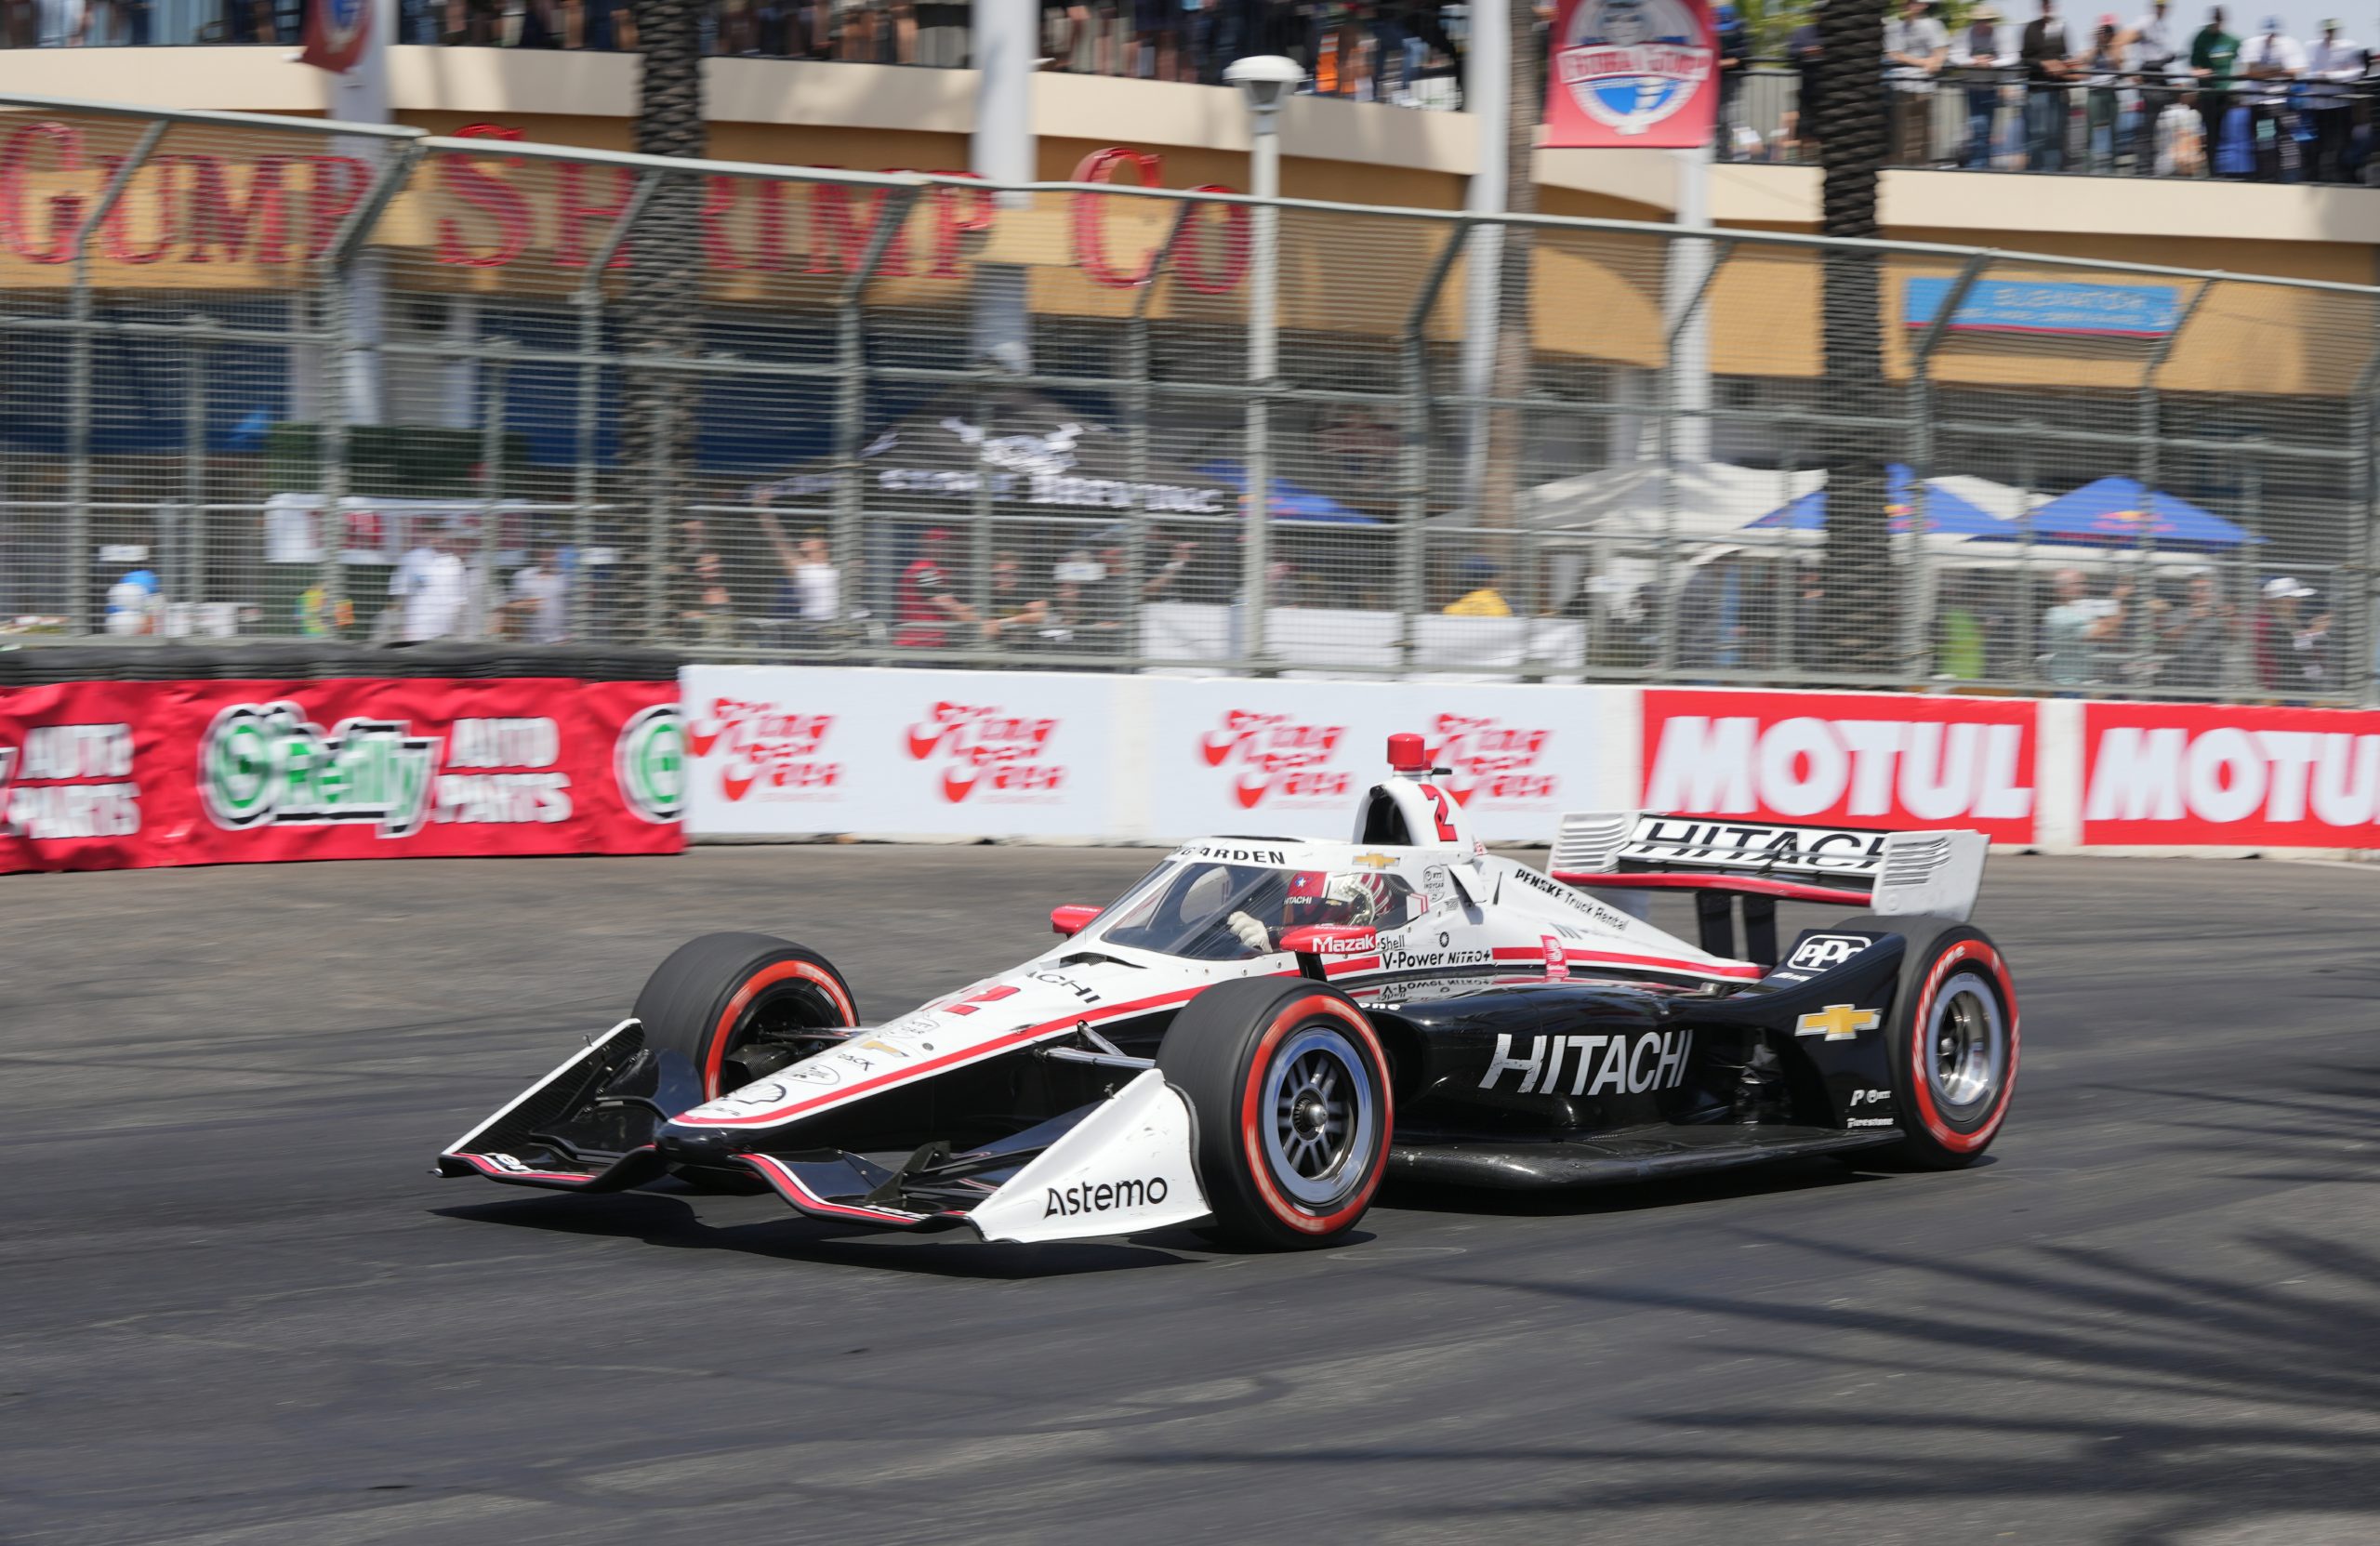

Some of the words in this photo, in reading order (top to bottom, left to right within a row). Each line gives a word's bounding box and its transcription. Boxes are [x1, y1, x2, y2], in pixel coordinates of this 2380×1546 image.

[0, 122, 377, 264] GUMP
[19, 723, 134, 779] AUTO
[448, 718, 560, 768] AUTO
[1646, 715, 2034, 819] MOTUL
[437, 773, 572, 823] PARTS
[2085, 727, 2380, 826] MOTU
[9, 783, 140, 839] PARTS
[1418, 784, 1458, 841] 2
[1177, 846, 1286, 865] GARDEN
[1637, 823, 1885, 870] HITAC
[1283, 896, 1314, 905] HITACHI
[1514, 868, 1565, 900] PENSKE
[1564, 892, 1594, 915] Truck
[1593, 906, 1630, 932] Rental
[1312, 933, 1375, 953] Mazak
[1381, 934, 1406, 950] Shell
[1382, 951, 1445, 970] V-Power
[1478, 1029, 1694, 1096] HITACHI
[1846, 1117, 1894, 1129] Firestone
[1043, 1176, 1168, 1220] Astemo
